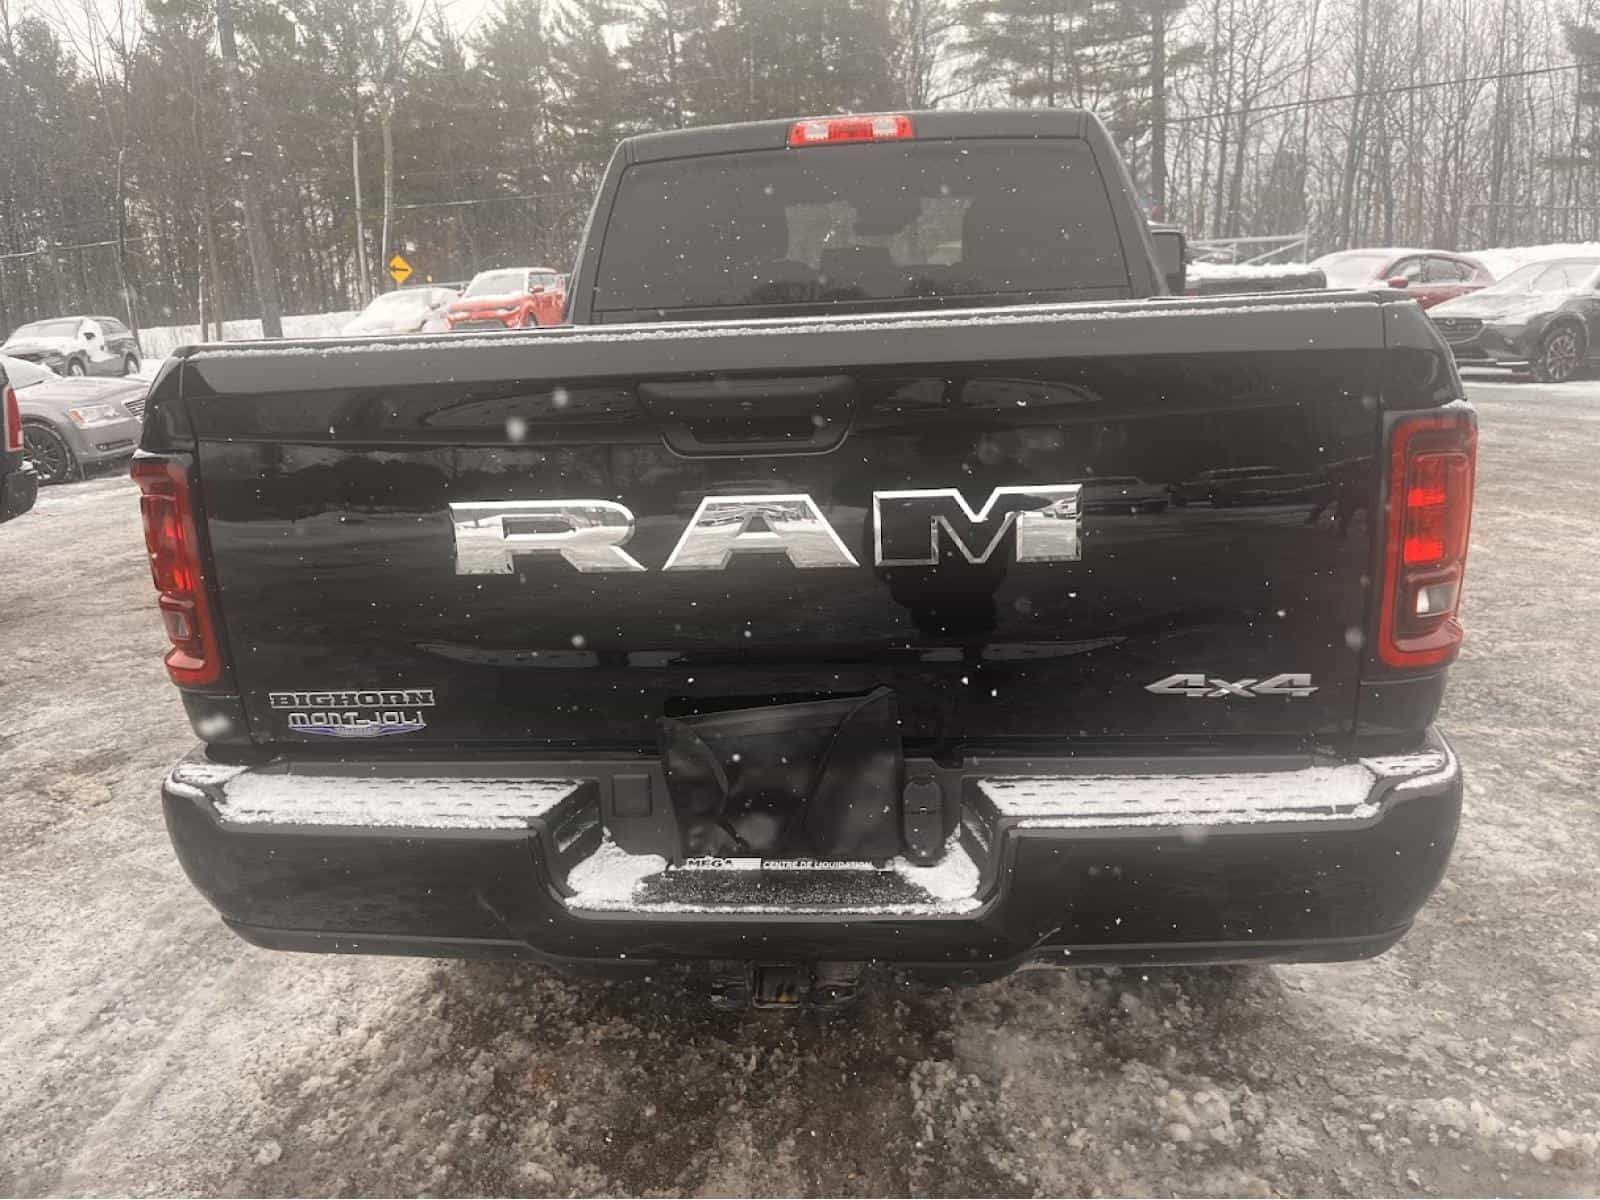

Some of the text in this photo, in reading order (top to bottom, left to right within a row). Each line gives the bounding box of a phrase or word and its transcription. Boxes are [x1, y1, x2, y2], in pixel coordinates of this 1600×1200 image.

[449, 483, 1084, 576] RAM
[1143, 673, 1320, 697] 4x4
[268, 690, 436, 709] BIGHORN
[762, 860, 798, 871] CENTRE
